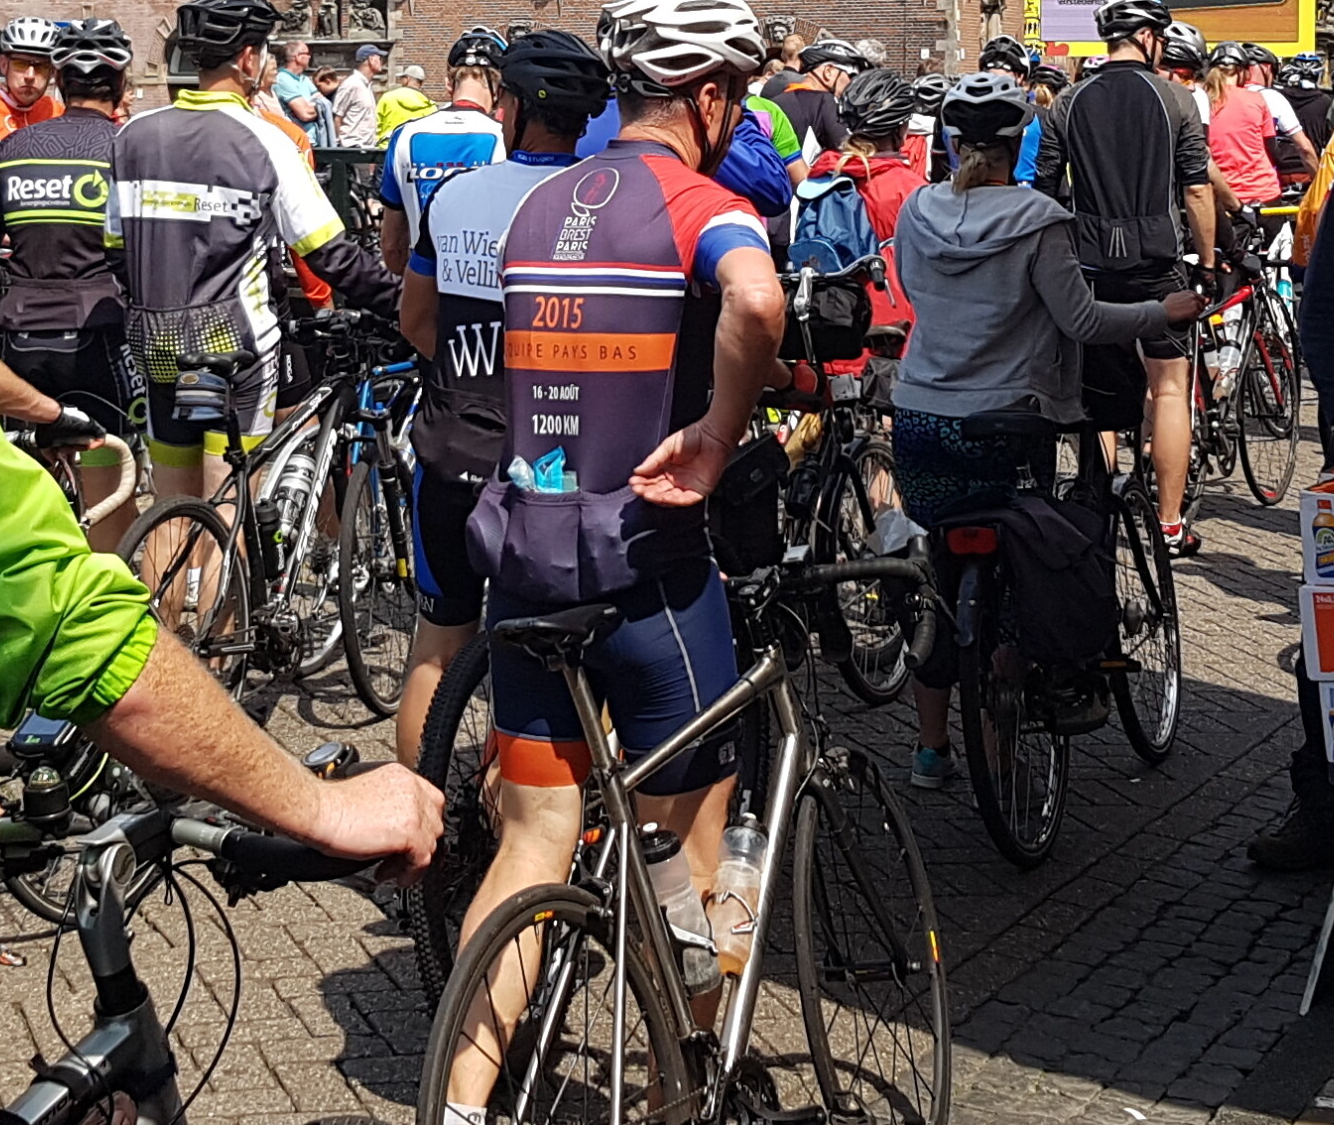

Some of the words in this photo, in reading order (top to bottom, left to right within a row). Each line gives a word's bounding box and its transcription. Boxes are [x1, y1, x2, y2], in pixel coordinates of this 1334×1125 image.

[7, 174, 73, 202] Reset
[193, 196, 229, 213] Reset
[563, 215, 598, 228] PARIS
[462, 229, 499, 259] Wie
[559, 228, 594, 241] BREST
[555, 240, 589, 252] PARIS
[441, 258, 453, 283] &
[531, 295, 585, 329] 2015
[507, 341, 543, 358] QUIPE
[553, 344, 588, 360] PAYS
[599, 345, 637, 361] BAS
[532, 385, 543, 400] 16
[548, 385, 559, 400] 20
[531, 413, 562, 435] 1200
[563, 415, 580, 436] KM
